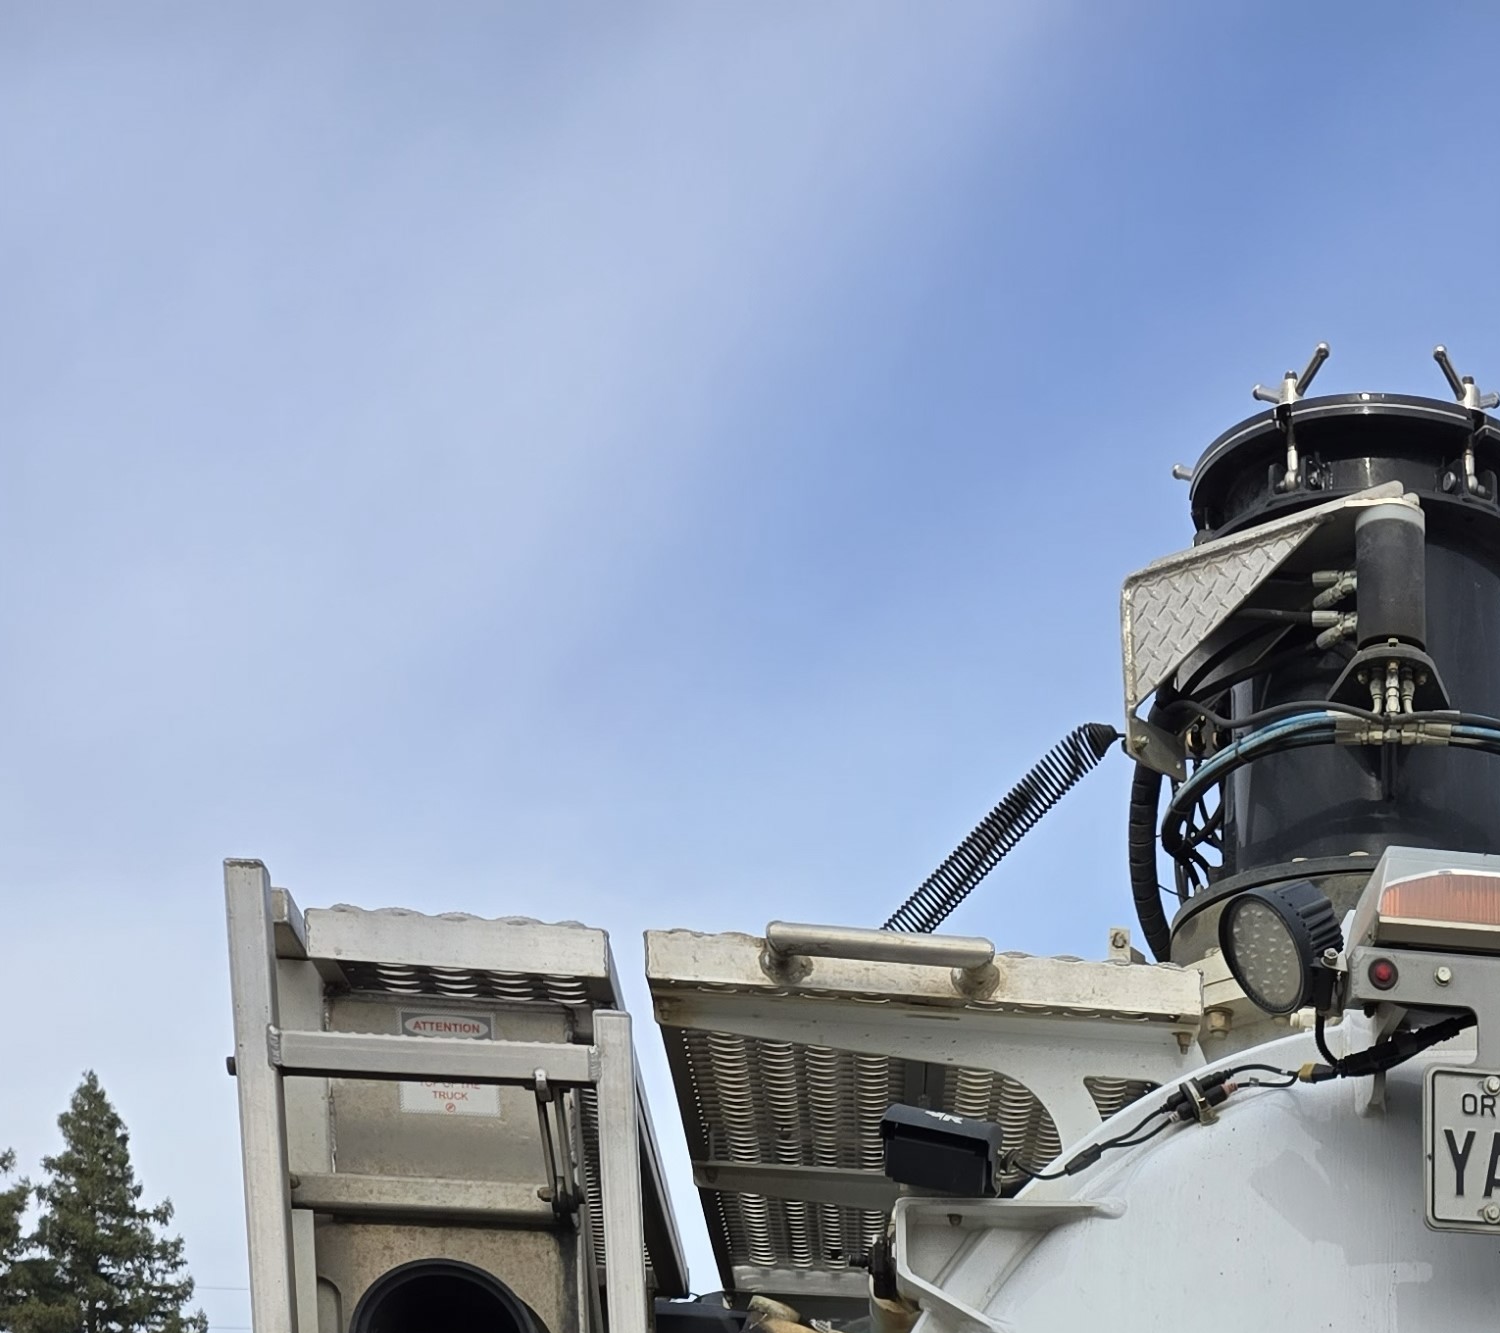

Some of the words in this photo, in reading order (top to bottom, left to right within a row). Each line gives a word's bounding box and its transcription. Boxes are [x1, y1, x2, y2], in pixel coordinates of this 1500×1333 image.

[413, 1020, 480, 1034] ATTENTION
[432, 1091, 469, 1101] TRUCK
[1462, 1094, 1497, 1118] OR
